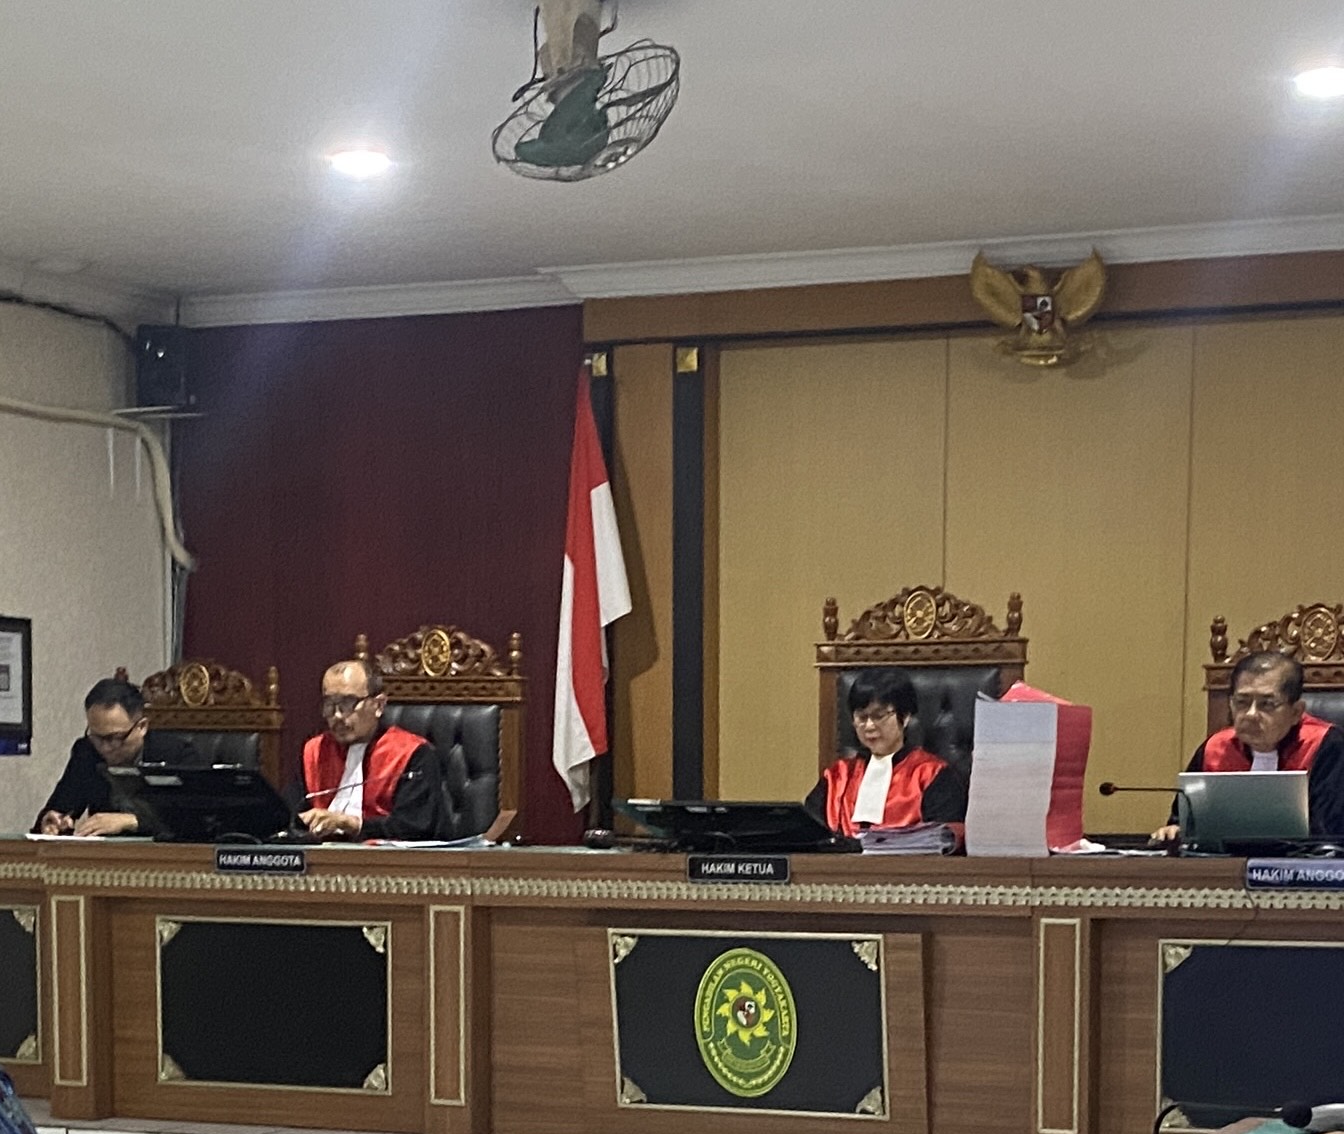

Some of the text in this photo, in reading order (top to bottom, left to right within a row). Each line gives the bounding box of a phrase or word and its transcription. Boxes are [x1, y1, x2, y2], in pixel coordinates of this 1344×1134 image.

[219, 854, 301, 866] HAKIM ANGGOTA
[701, 862, 774, 875] HAKIM KETUA
[1252, 868, 1294, 881] HAKIM
